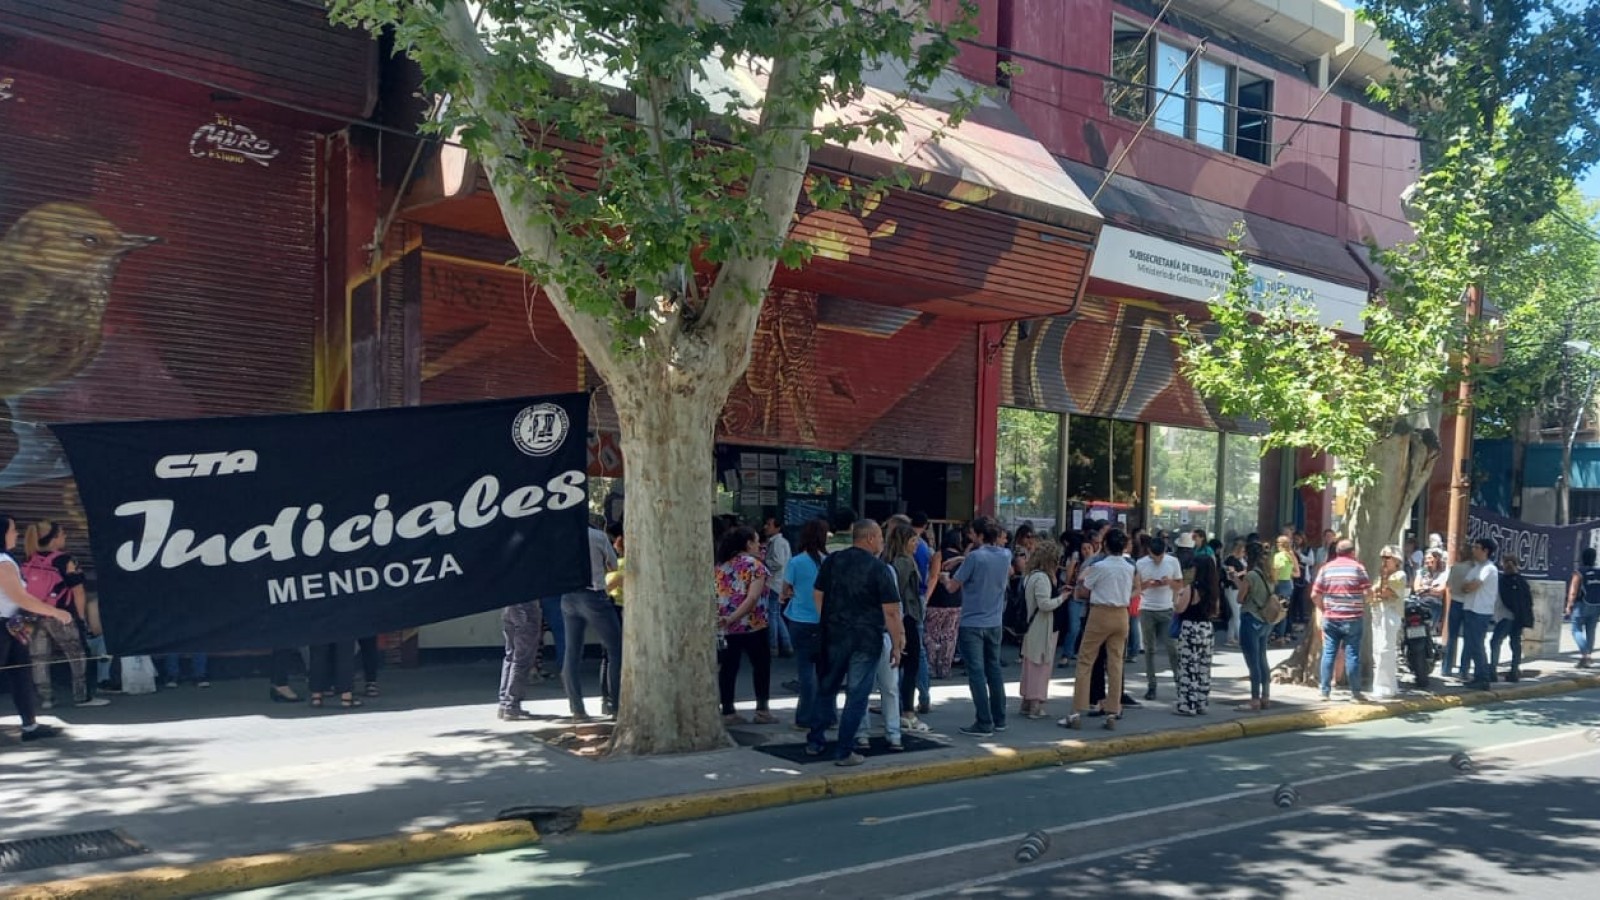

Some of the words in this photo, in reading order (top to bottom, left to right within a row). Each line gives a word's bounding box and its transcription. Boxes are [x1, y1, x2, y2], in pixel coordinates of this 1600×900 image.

[1128, 248, 1182, 270] SUBSECRETARÍA
[1182, 261, 1193, 273] DE
[1191, 264, 1221, 279] TRABAJO
[155, 449, 258, 479] CTA
[114, 469, 587, 572] Judiciales
[267, 552, 464, 605] MENDOZA
